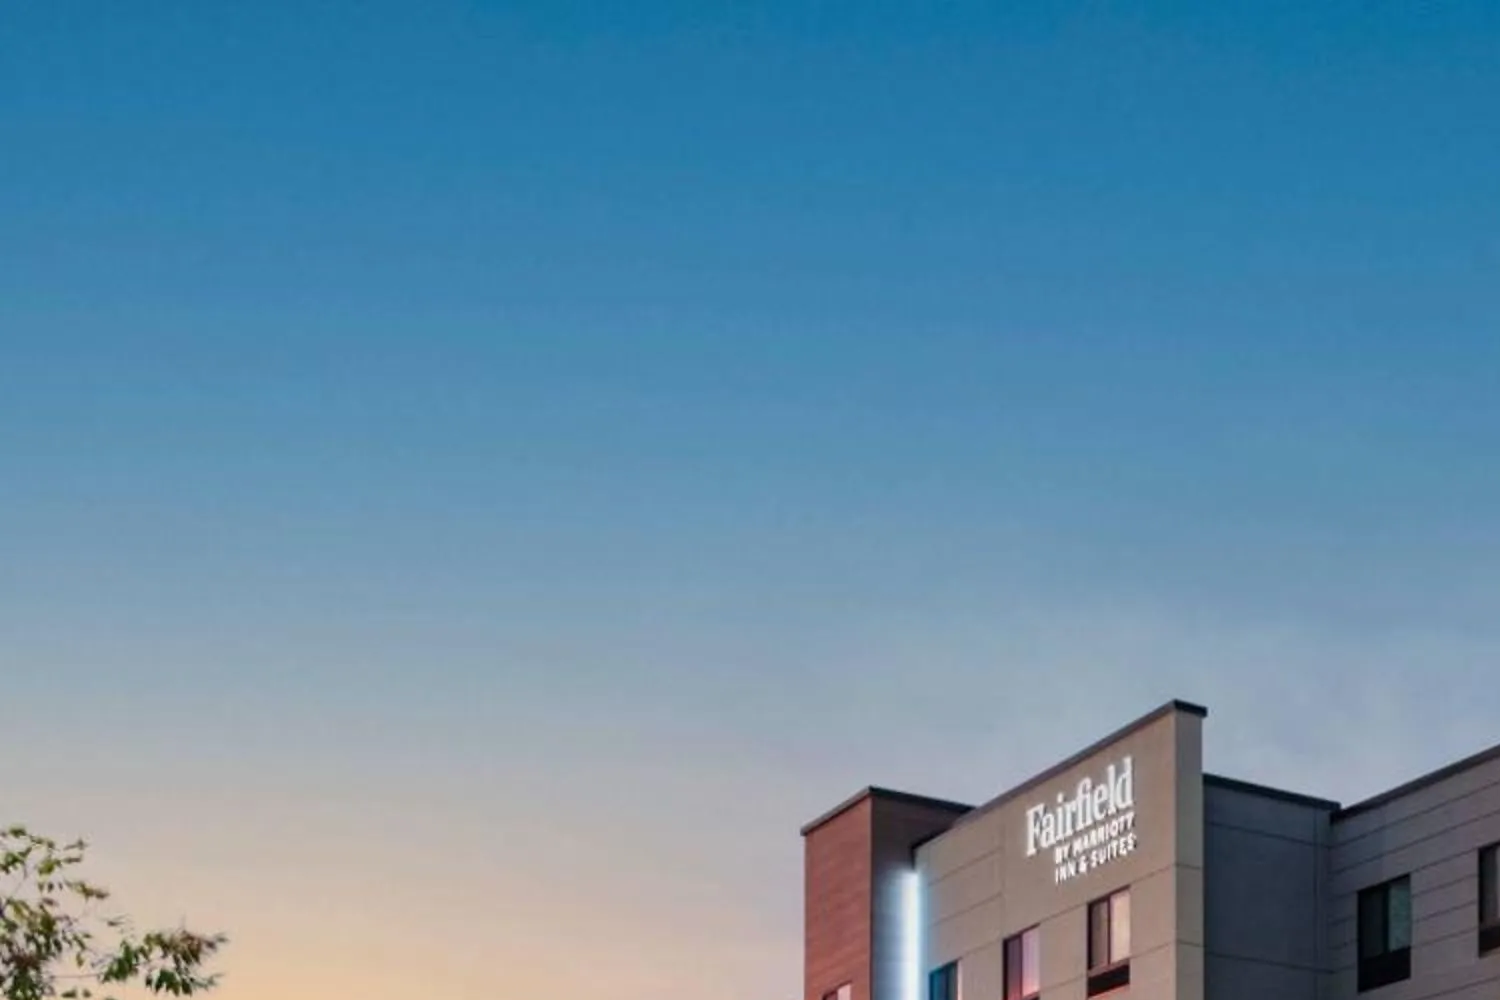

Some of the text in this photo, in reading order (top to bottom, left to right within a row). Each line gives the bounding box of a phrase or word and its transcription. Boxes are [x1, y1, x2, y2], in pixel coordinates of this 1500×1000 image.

[1026, 756, 1134, 857] Fairfield
[1055, 832, 1135, 884] INN & SUITES
